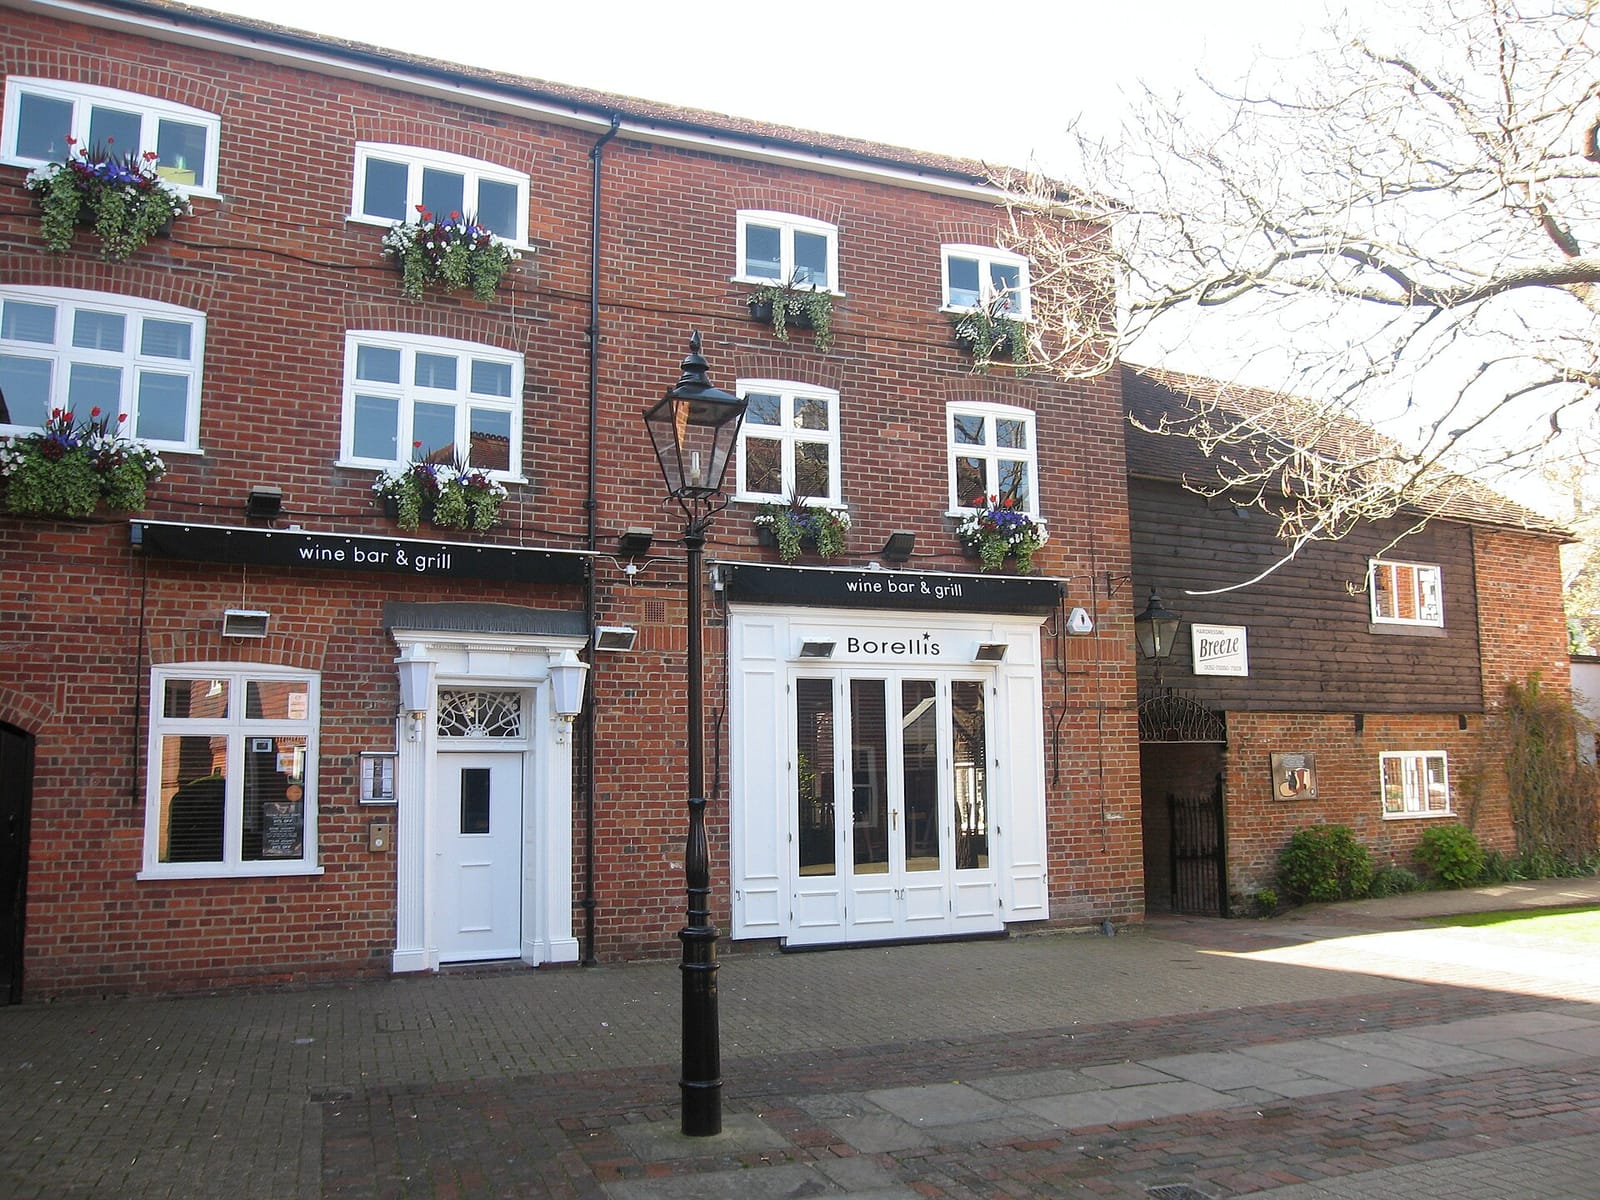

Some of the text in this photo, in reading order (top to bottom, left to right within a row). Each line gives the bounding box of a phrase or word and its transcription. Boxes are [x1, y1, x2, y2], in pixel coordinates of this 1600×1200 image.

[299, 544, 451, 572] wine bar & grill
[846, 578, 963, 599] wine bar & grill
[847, 636, 940, 656] Borellis
[1200, 637, 1239, 658] Breeze
